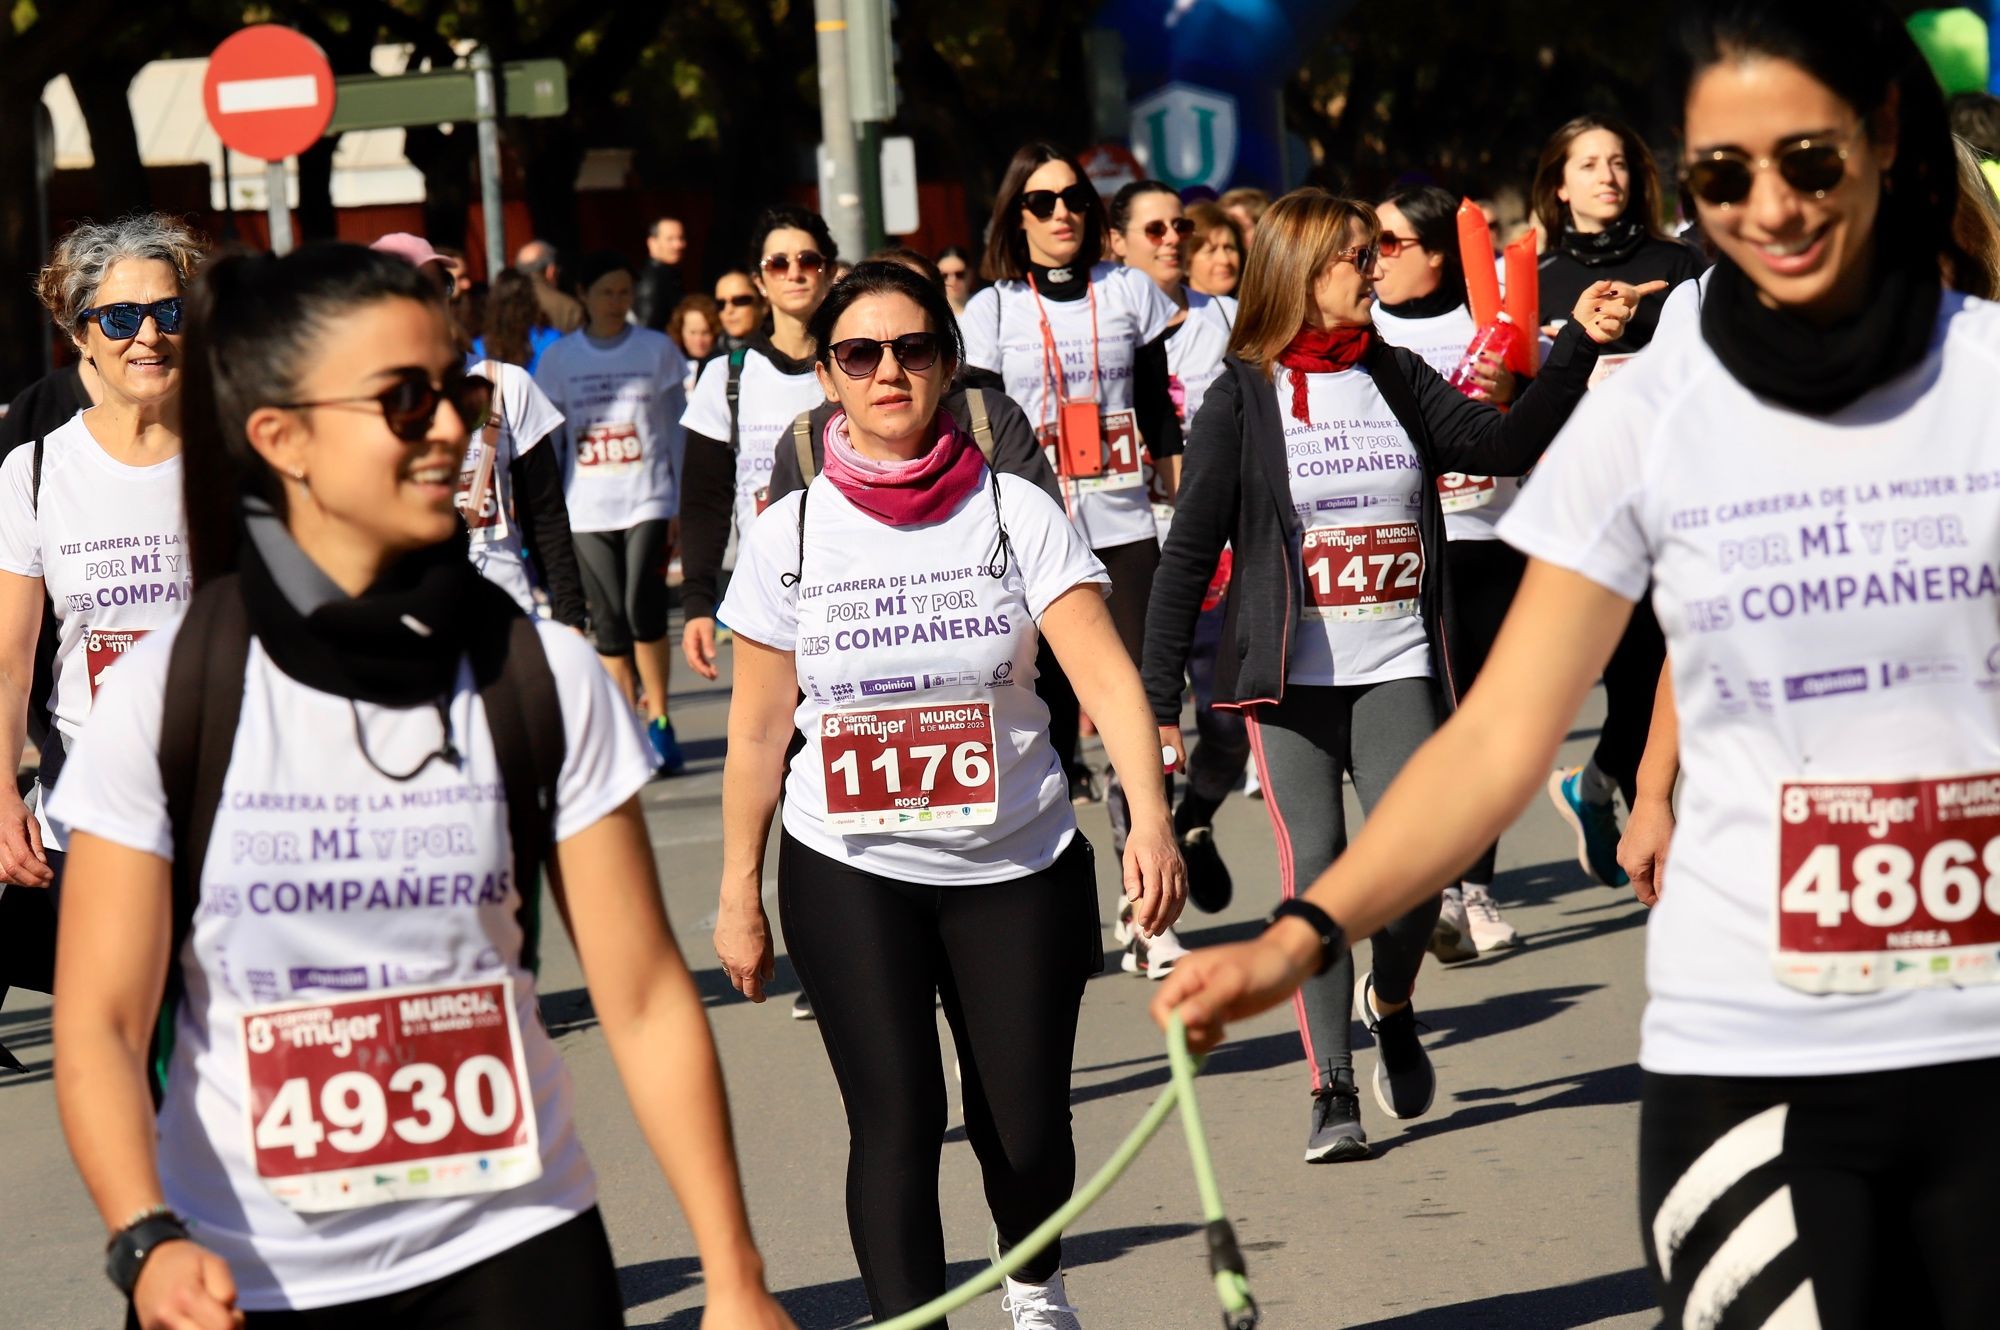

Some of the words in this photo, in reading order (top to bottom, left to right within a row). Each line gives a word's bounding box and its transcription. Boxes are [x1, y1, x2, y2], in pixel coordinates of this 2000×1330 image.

[1146, 104, 1217, 189] U
[1065, 347, 1084, 365] MÍ
[1284, 421, 1331, 437] CARRERA
[1333, 420, 1347, 430] DE
[1349, 419, 1361, 429] LA
[1363, 420, 1393, 429] MUJER
[579, 436, 640, 463] 3189
[1287, 440, 1321, 458] POR
[1325, 430, 1350, 452] MÍ
[1352, 436, 1365, 450] Y
[1368, 435, 1401, 449] POR
[1716, 492, 1812, 523] CARRERA
[1821, 486, 1846, 508] DE
[1856, 484, 1880, 503] LA
[1889, 475, 1956, 497] MUJER
[60, 543, 81, 555] VIII
[85, 537, 140, 552] CARRERA
[145, 535, 160, 546] DE
[165, 535, 180, 545] LA
[1328, 535, 1367, 552] mujer
[1376, 527, 1416, 539] MURCIA
[1719, 533, 1792, 573] POR
[1800, 510, 1851, 558] MÍ
[1860, 522, 1886, 554] Y
[1892, 514, 1968, 552] POR
[86, 559, 127, 580] POR
[131, 547, 161, 574] MÍ
[166, 555, 181, 572] Y
[1308, 552, 1420, 594] 1472
[97, 575, 192, 606] COMPAÑ
[802, 586, 823, 599] VIII
[826, 577, 886, 594] CARRERA
[890, 576, 907, 588] DE
[911, 574, 927, 586] LA
[931, 568, 973, 583] MUJER
[1360, 595, 1377, 603] ANA
[1742, 559, 1998, 621] COMPAÑERA
[827, 601, 870, 622] POR
[875, 589, 907, 617] MÍ
[912, 596, 927, 613] Y
[932, 590, 978, 612] POR
[802, 636, 830, 656] MIS
[835, 614, 1011, 651] COMPAÑERAS
[843, 714, 877, 723] carrera
[854, 719, 906, 743] mujer
[920, 708, 983, 724] MURCIA
[939, 723, 965, 731] MARZO
[967, 721, 985, 729] 2023
[831, 741, 991, 796] 1176
[232, 791, 328, 813] CARRERA
[335, 793, 360, 813] DE
[368, 791, 394, 811] LA
[402, 786, 468, 808] MUJER
[1828, 796, 1918, 838] mujer
[231, 830, 302, 865] POR
[311, 816, 360, 860] MÍ
[369, 830, 397, 860] Y
[402, 823, 477, 859] POR
[249, 867, 508, 915] COMPAÑERAS
[1781, 835, 2000, 927] 486
[1886, 929, 1951, 948] NEREA
[401, 991, 498, 1021] MURCIA
[292, 1014, 381, 1057] mujer
[256, 1054, 516, 1159] 4930
